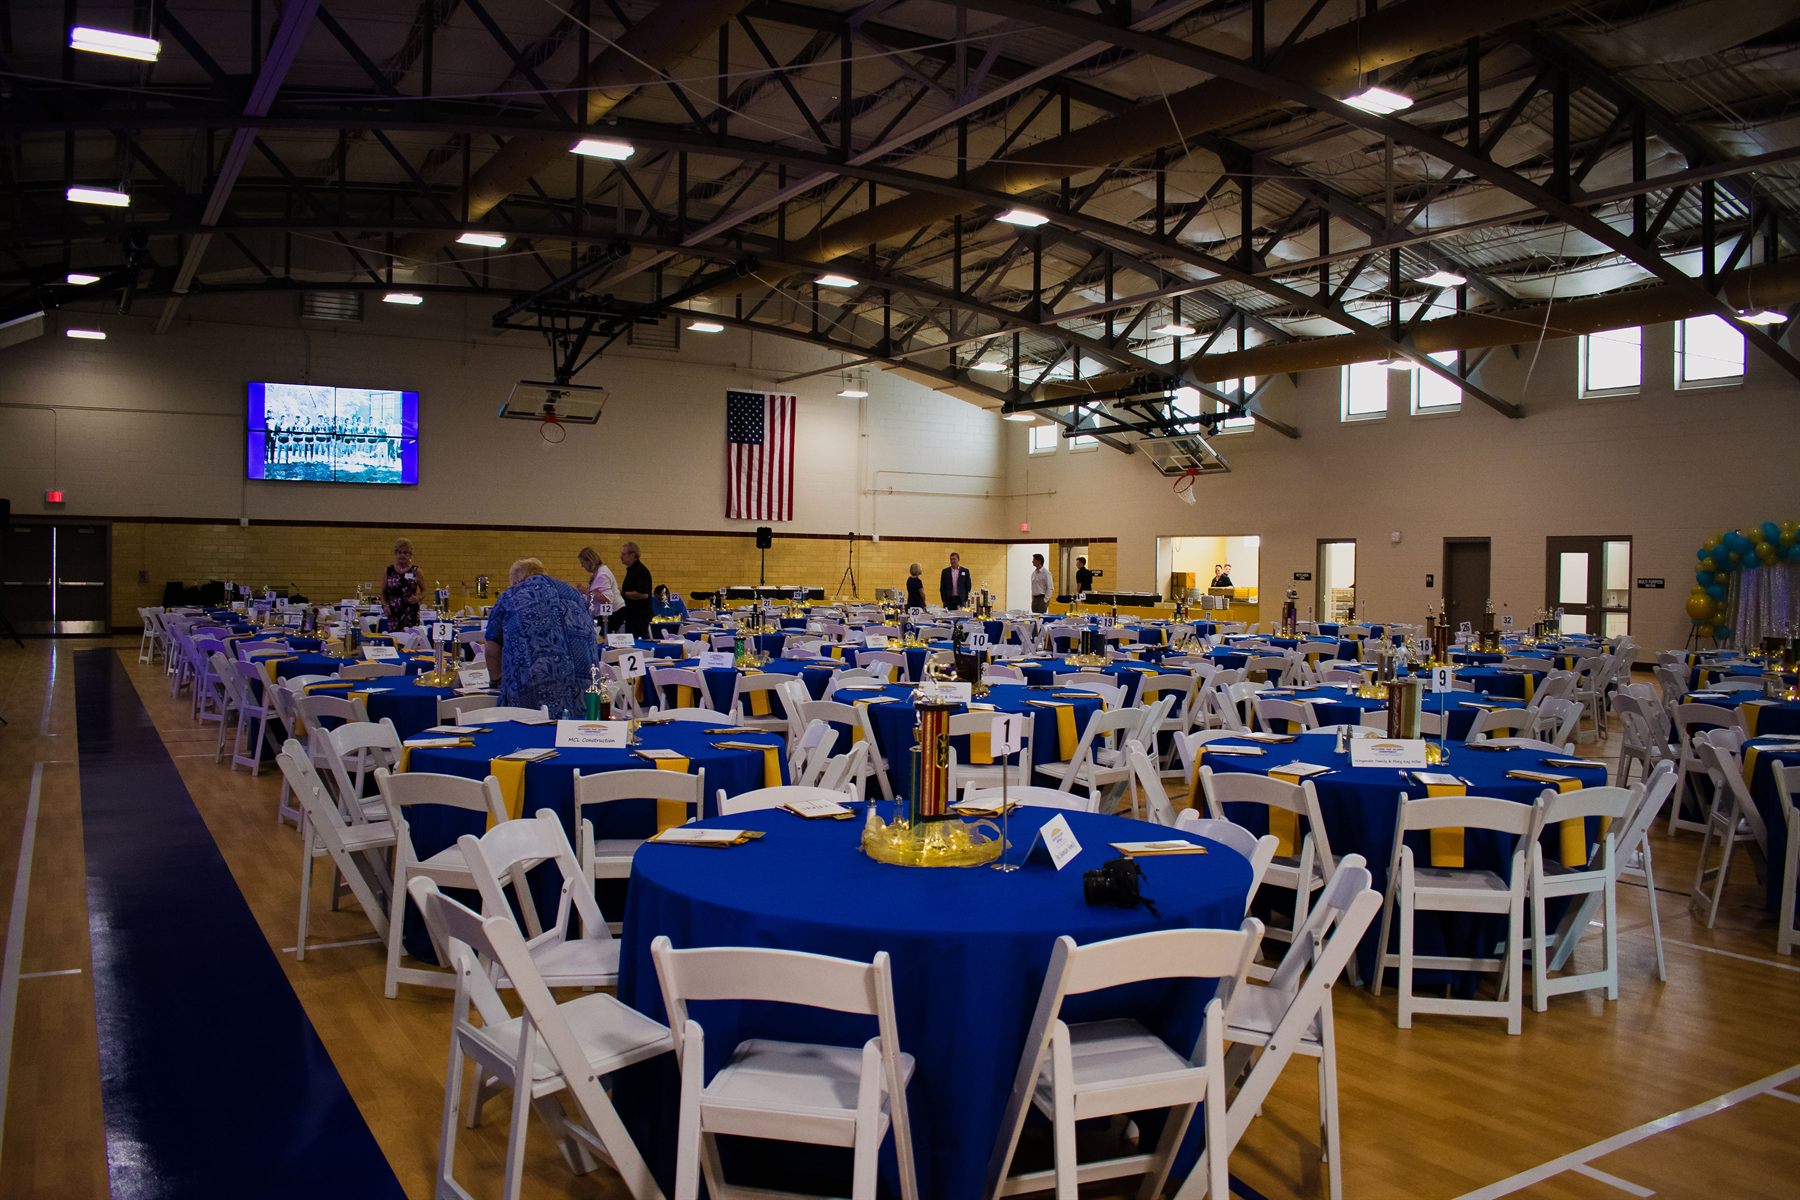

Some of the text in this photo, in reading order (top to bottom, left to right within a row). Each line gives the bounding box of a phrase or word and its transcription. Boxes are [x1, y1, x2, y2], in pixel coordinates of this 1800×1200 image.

[344, 608, 349, 616] 4
[602, 605, 611, 613] 12
[911, 608, 920, 616] 20
[1104, 618, 1113, 627] 19
[1503, 616, 1512, 624] 32
[439, 624, 446, 636] 3
[1461, 623, 1471, 632] 26
[973, 635, 985, 646] 10
[1421, 639, 1430, 651] 18
[627, 655, 638, 671] 2
[1439, 669, 1447, 686] 9
[1003, 718, 1010, 743] 1
